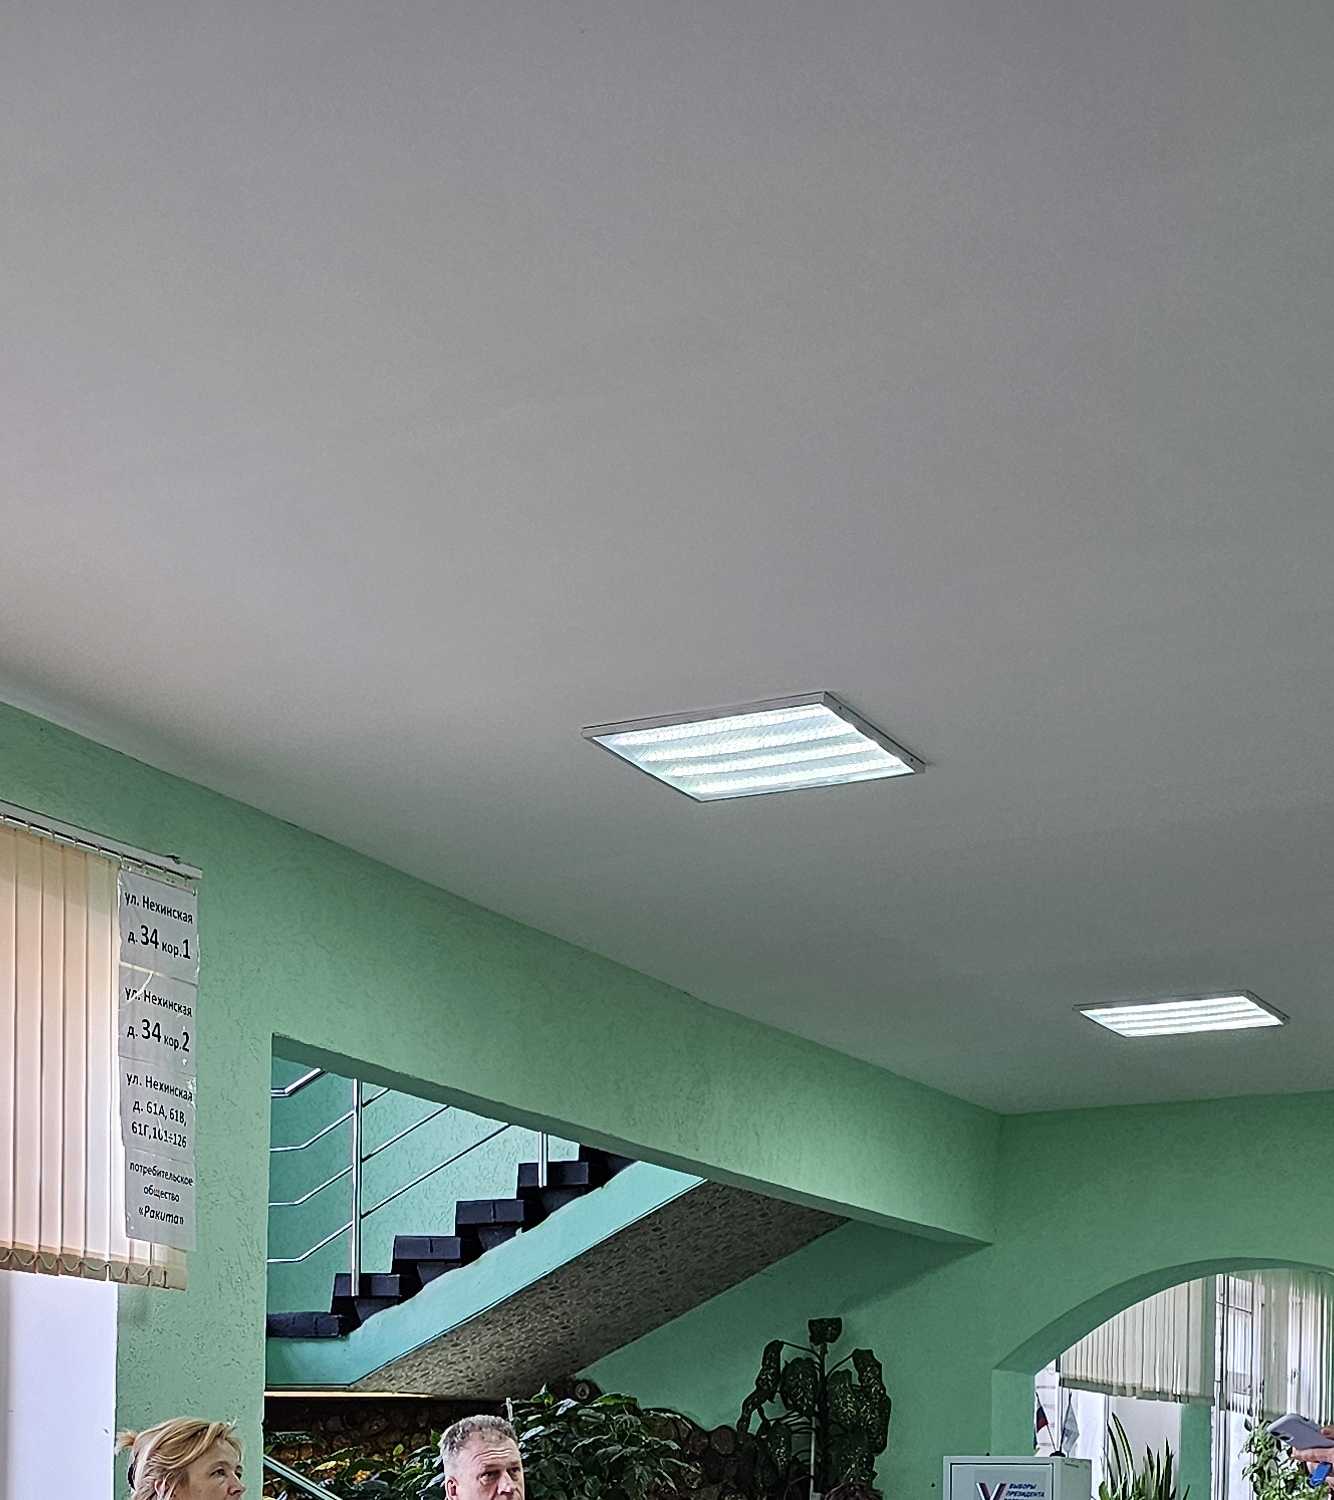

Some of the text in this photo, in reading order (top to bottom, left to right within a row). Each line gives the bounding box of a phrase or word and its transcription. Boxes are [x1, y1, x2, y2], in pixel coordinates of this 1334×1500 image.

[124, 892, 193, 925] ул. Нехинская
[127, 930, 138, 944] д.
[140, 924, 159, 950] 34
[124, 987, 193, 1018] ул. Нехинская
[126, 1025, 138, 1039] д.
[141, 1018, 161, 1043] 34
[126, 1072, 193, 1101] ул. Нехинская
[132, 1100, 144, 1114] д.
[129, 1161, 194, 1187] потребительское
[143, 1185, 180, 1203] общество
